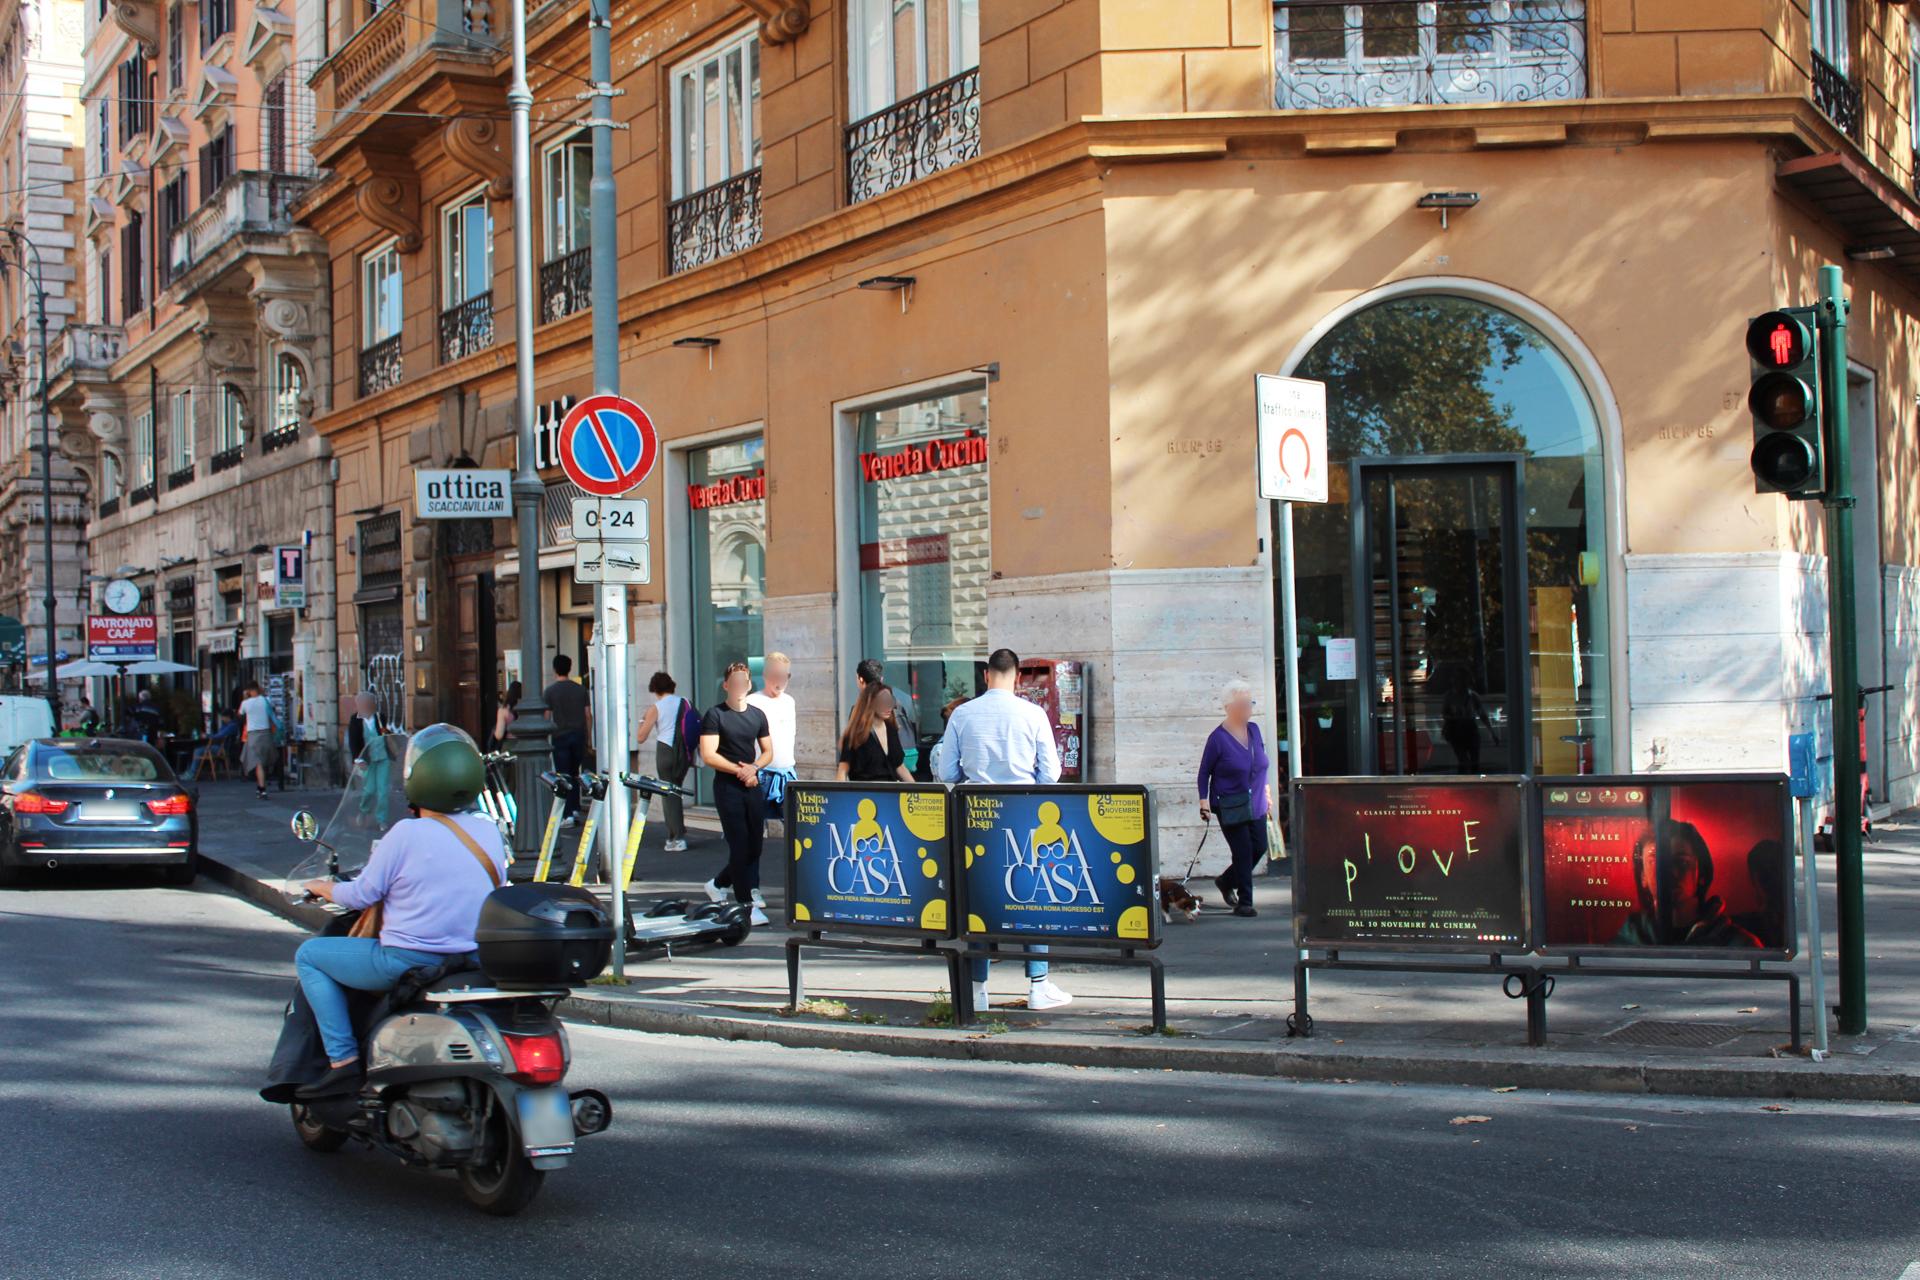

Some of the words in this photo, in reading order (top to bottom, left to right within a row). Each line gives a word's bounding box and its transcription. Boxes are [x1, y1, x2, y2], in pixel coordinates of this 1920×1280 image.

[860, 449, 923, 483] Veneta
[925, 429, 987, 474] Cucin
[428, 474, 504, 499] ottica
[687, 478, 731, 510] Veneta
[730, 468, 766, 504] Cuci
[428, 501, 504, 512] SCACCIAVILLANI
[282, 551, 299, 577] T
[91, 618, 153, 628] PATRONATO
[107, 628, 136, 639] CAAF
[1096, 794, 1111, 805] 29
[1098, 805, 1105, 816] 6
[1344, 821, 1481, 901] PIOVE
[1567, 855, 1628, 863] RIAFFIORA
[827, 857, 912, 897] CASA
[1004, 863, 1104, 904] CASA
[1571, 899, 1631, 907] PROFONDO
[1349, 920, 1363, 928] DAL
